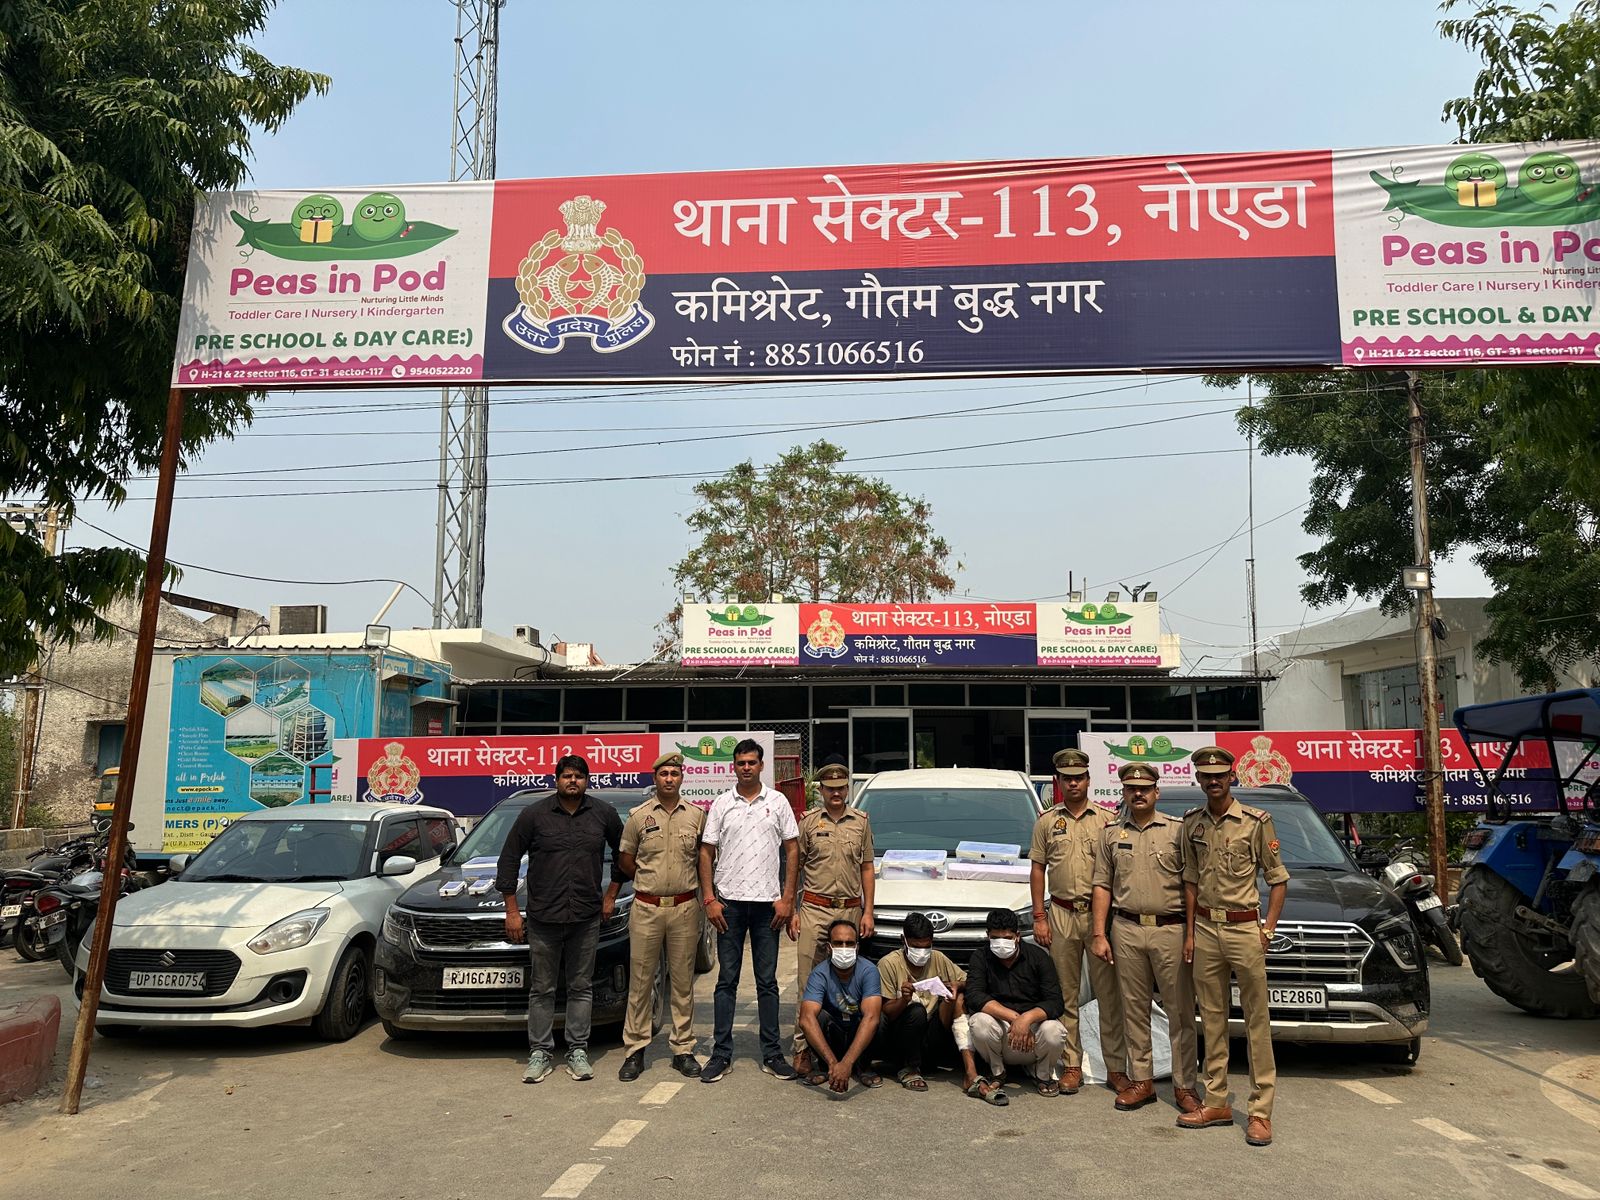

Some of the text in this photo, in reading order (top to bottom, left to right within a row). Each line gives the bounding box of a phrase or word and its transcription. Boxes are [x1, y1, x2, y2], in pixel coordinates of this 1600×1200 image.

[672, 163, 1316, 246] थाना सेक्टर-113, नोएडा
[1381, 230, 1600, 266] Peas in Po
[1542, 266, 1600, 276] Nurturing Lit
[229, 260, 447, 296] Peas in Pod
[1386, 282, 1438, 293] Toddler
[1442, 281, 1475, 292] Care
[1486, 280, 1541, 292] Nursery
[1552, 279, 1600, 290] Kinder
[361, 294, 444, 304] Nurturing Little Minds
[843, 272, 944, 319] गौतम
[950, 280, 1020, 334] बुद्ध
[1027, 279, 1106, 316] नगर
[229, 310, 271, 320] Toddler
[274, 309, 302, 319] Care
[311, 308, 357, 319] Nursery
[367, 306, 444, 317] Kindergarten
[1353, 305, 1593, 326] PRE SCHOOL & DAY
[515, 316, 646, 347] उत्तर प्रदेश पुलिस
[194, 327, 473, 350] PRE SCHOOL & DAY CARE:)
[670, 338, 718, 369] फोन
[721, 338, 743, 367] नं
[764, 339, 925, 368] 8851066516
[1369, 346, 1585, 358] H-21 & 22 sector 116, GT- 31 sector-117
[201, 367, 384, 379] H-21 & 22 sector 116, GT- 31 sector-117
[409, 366, 473, 376] 9540522220
[852, 604, 1032, 630] थाना सेक्टर-113, नोएडा
[708, 626, 772, 637] Peas in Pod
[1064, 625, 1131, 636] Peas in Pod
[685, 646, 701, 654] PRE
[703, 646, 738, 654] SCHOOL
[740, 646, 747, 654] &
[748, 646, 766, 654] DAY
[903, 634, 931, 650] गौतम
[933, 639, 952, 655] बुद्ध
[954, 639, 976, 650] नगर
[1060, 645, 1097, 653] SCHOOL
[1098, 645, 1106, 653] &
[1107, 645, 1126, 653] DAY
[853, 653, 868, 663] फोन
[880, 655, 927, 664] 8851066516
[427, 748, 472, 767] थाना
[585, 738, 643, 767] नोएडा
[1296, 740, 1344, 759] थाना
[1346, 732, 1461, 762] सेक्टर-13,
[681, 763, 710, 775] Peas
[713, 763, 726, 774] in
[1163, 763, 1191, 775] Pod
[614, 772, 640, 785] नगर
[331, 794, 353, 803] ARE:)
[681, 788, 715, 796] SCHOOL
[716, 788, 723, 796] &
[1094, 788, 1111, 796] PRE
[1461, 793, 1532, 806] 88516516
[202, 819, 219, 830] (P)
[451, 972, 520, 985] RJ16CA7936
